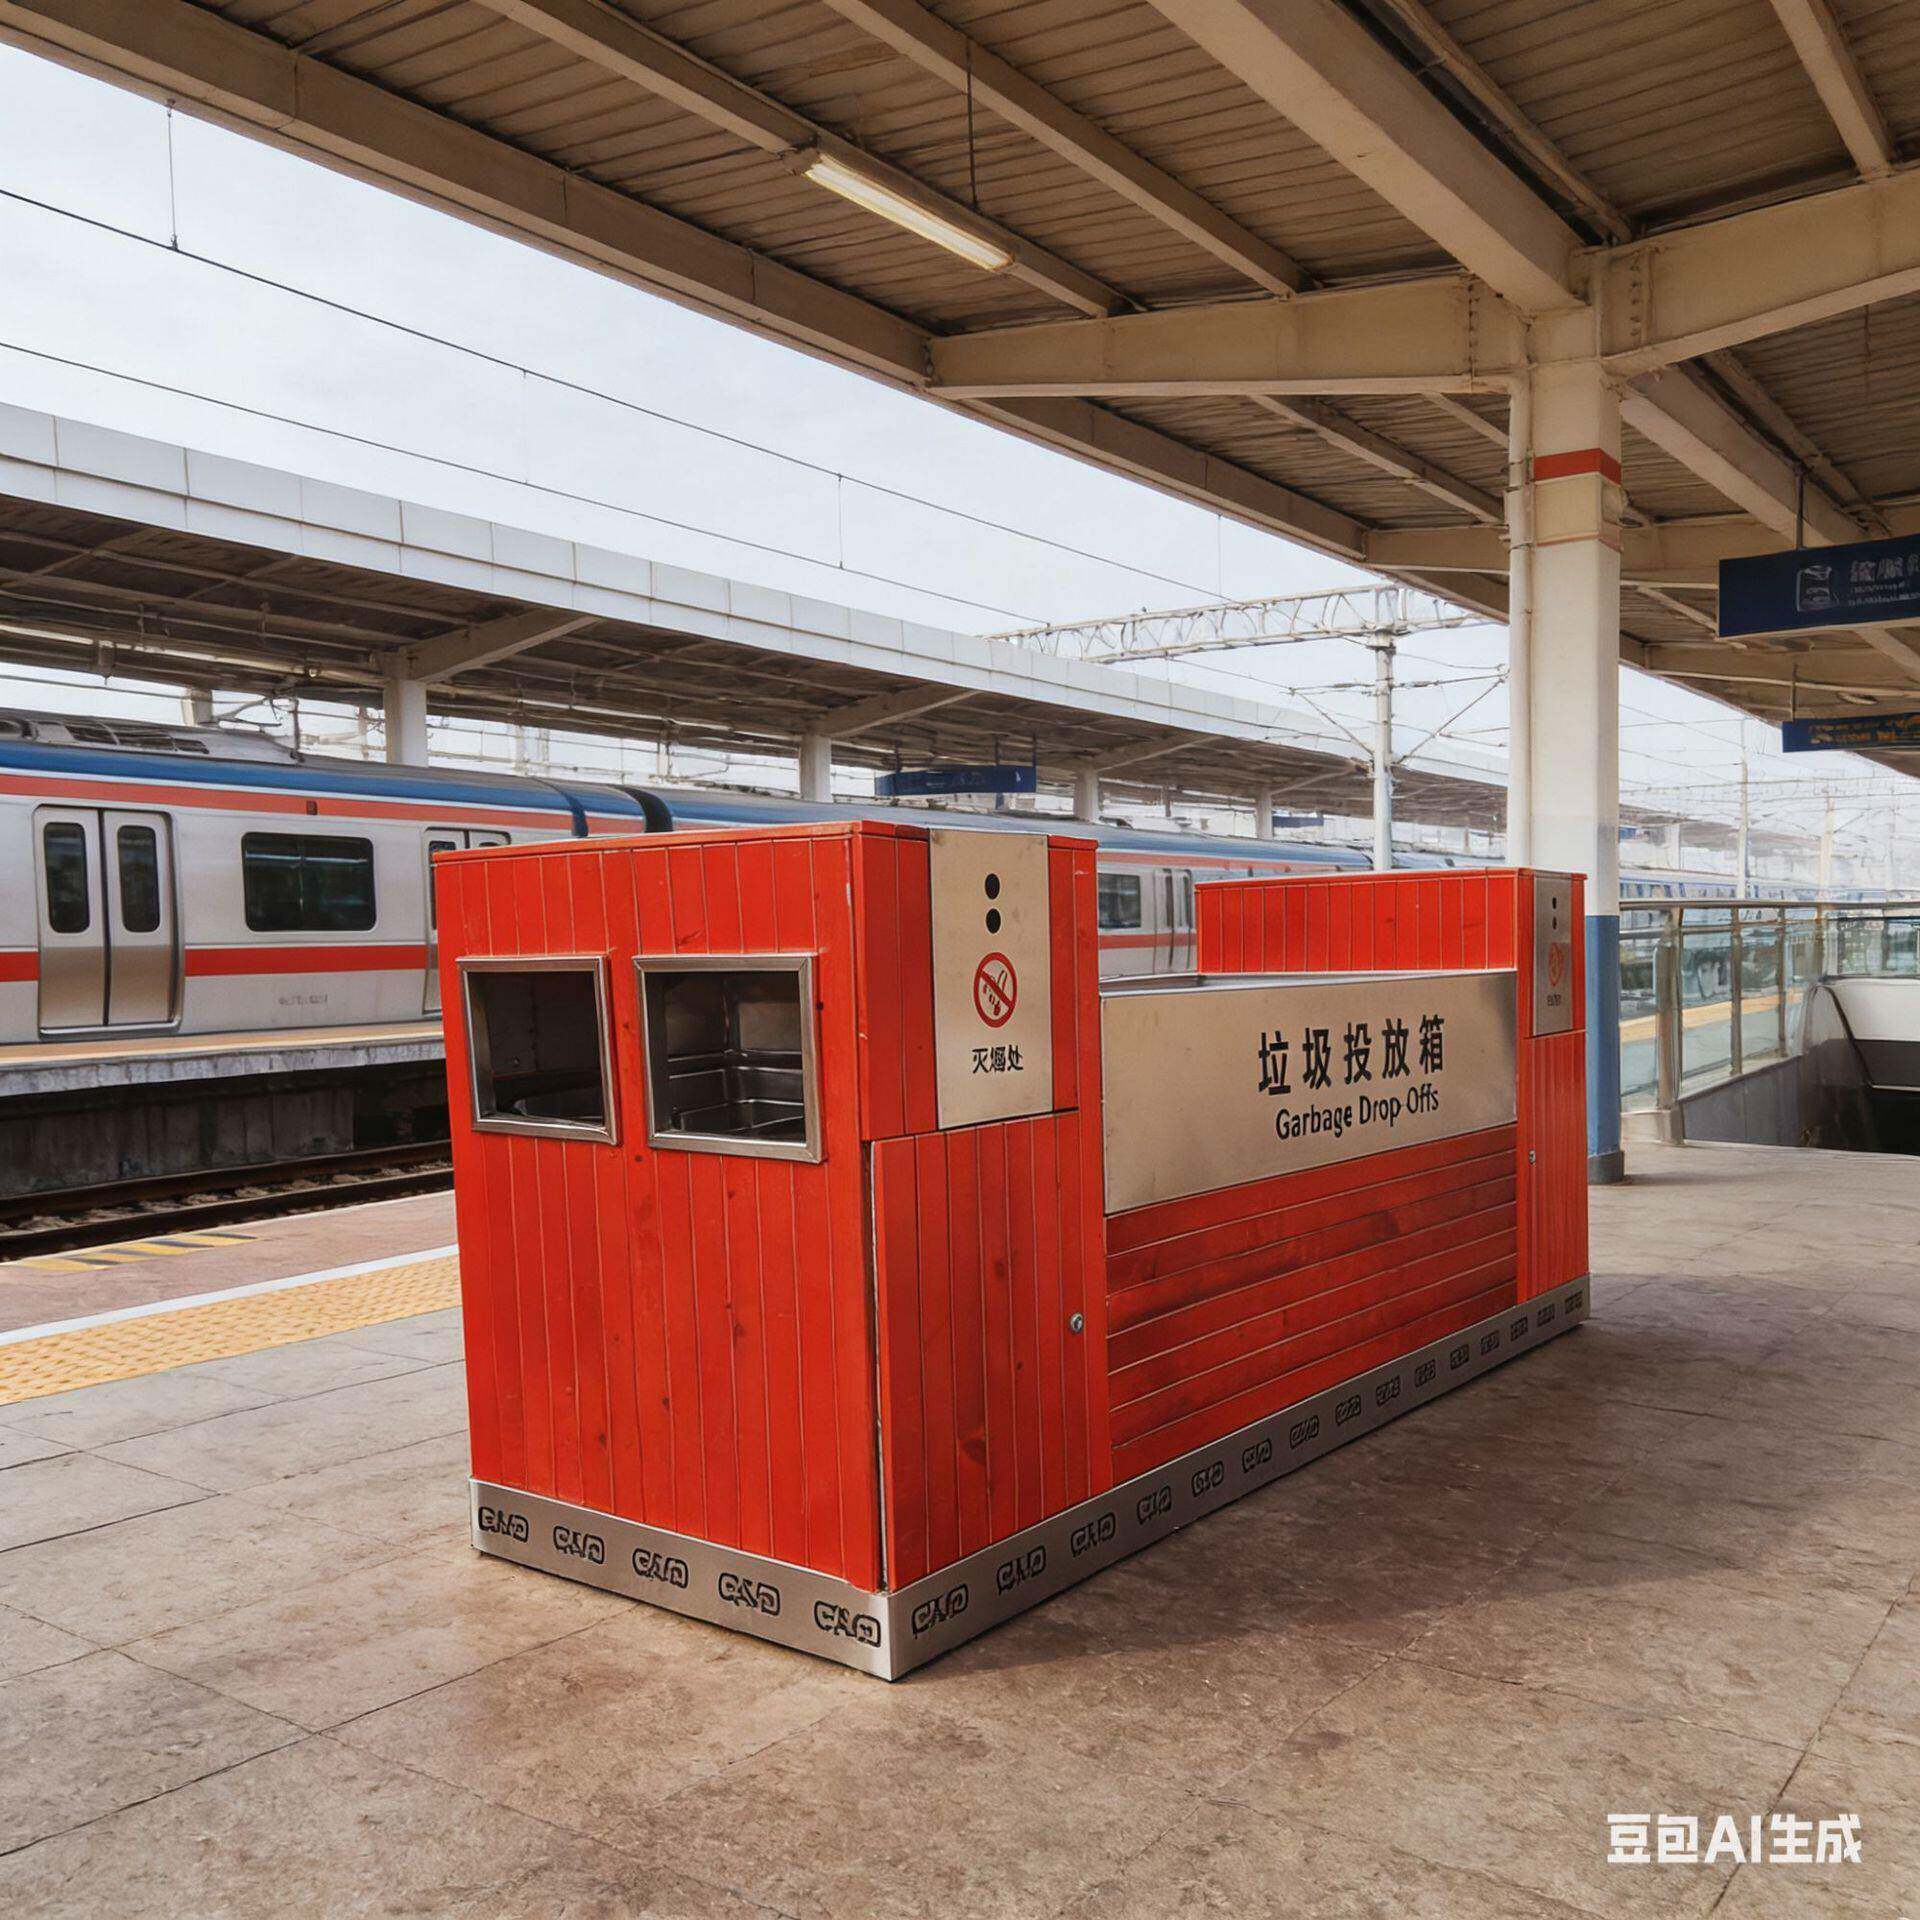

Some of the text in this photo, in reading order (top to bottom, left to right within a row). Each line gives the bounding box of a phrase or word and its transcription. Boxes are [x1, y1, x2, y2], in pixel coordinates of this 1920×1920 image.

[1258, 1014, 1445, 1096] 垃圾投放箱
[1275, 1083, 1439, 1141] Garbage Drop Offs
